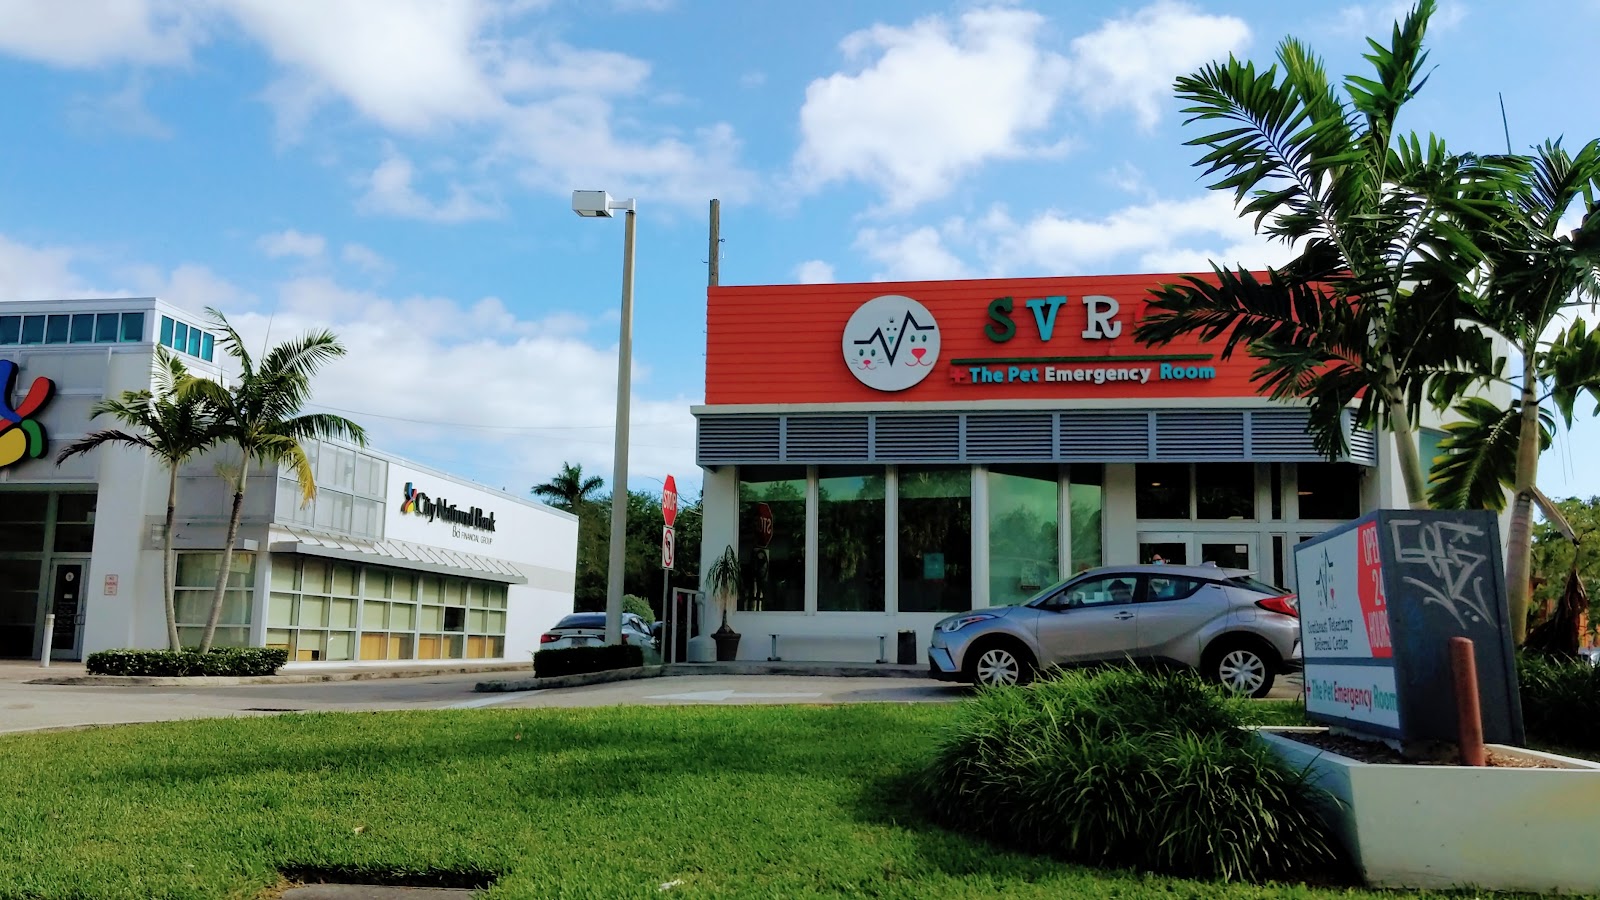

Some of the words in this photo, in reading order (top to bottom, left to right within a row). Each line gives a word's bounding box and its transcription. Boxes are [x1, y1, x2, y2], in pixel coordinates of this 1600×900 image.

[969, 366, 1004, 383] The
[1008, 366, 1039, 383] Pet
[1045, 366, 1151, 385] Emergency
[1160, 363, 1216, 380] Room
[663, 489, 676, 511] STOP
[436, 497, 474, 527] National
[474, 507, 496, 532] Bank
[1311, 680, 1322, 700] The
[1323, 680, 1333, 701] Pet
[1334, 681, 1372, 712] Emergency
[1373, 684, 1398, 711] Room
